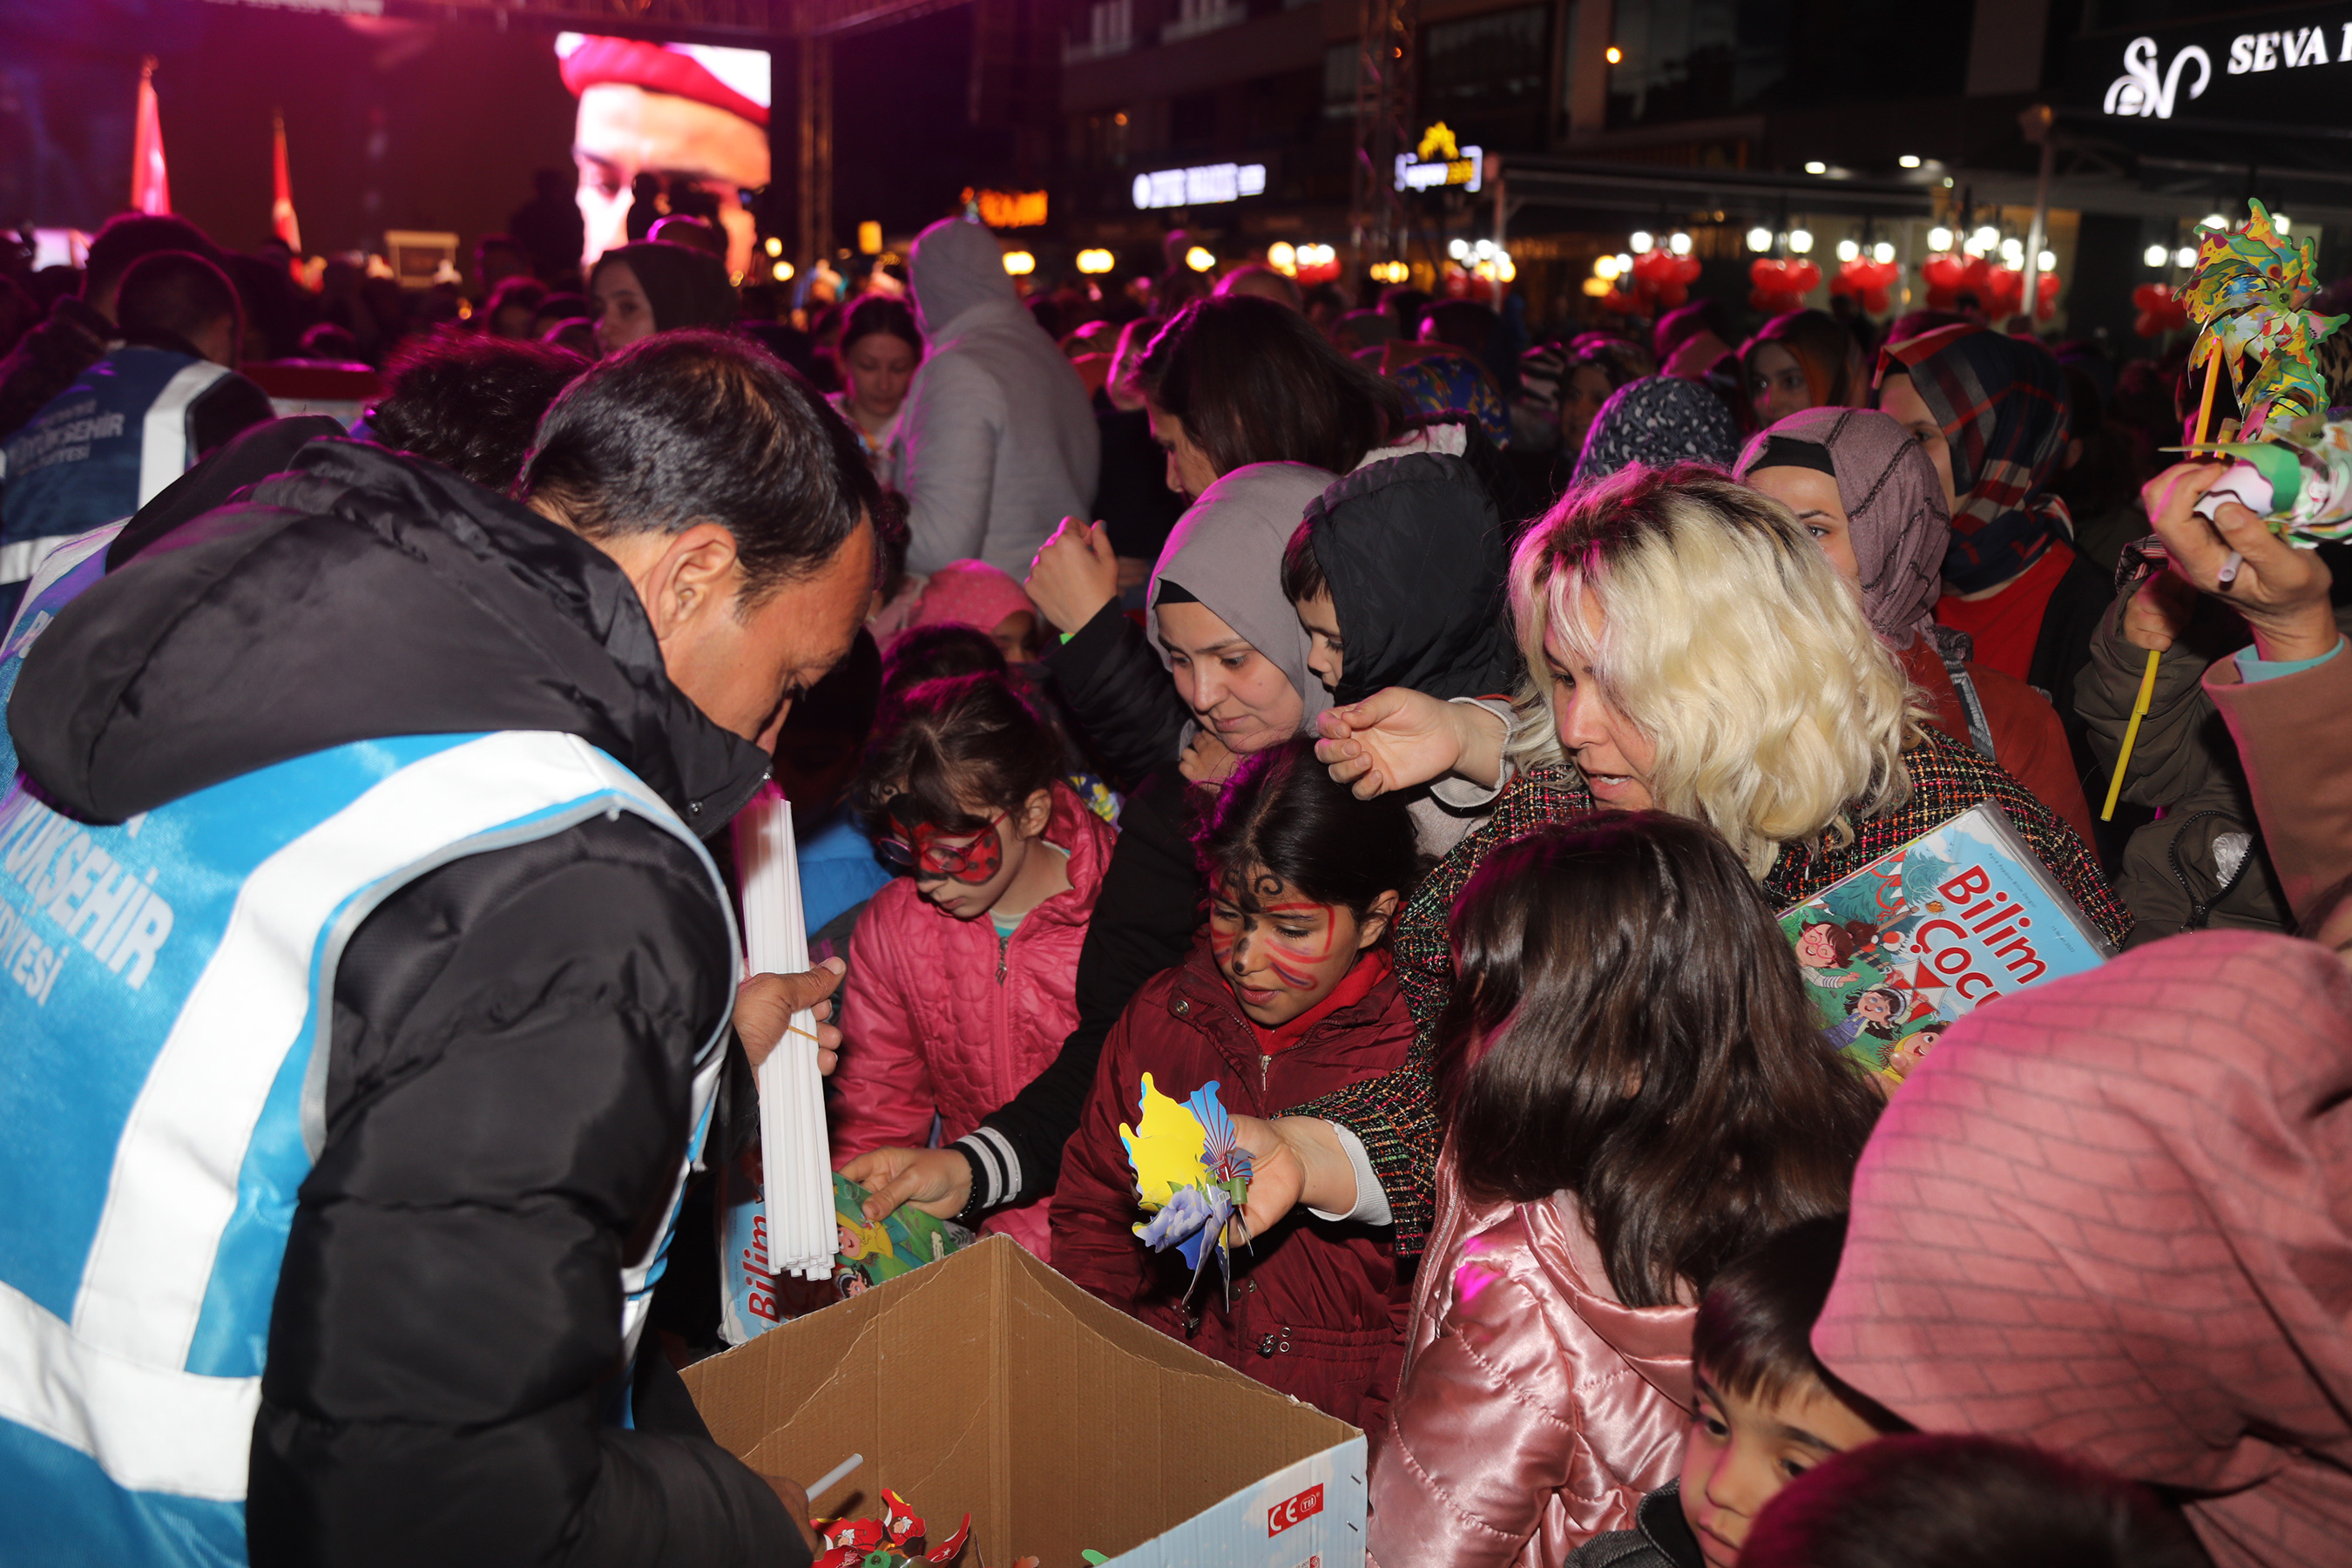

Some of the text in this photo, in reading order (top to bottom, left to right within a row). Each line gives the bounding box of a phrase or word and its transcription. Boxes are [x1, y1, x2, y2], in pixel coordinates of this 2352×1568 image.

[2227, 26, 2329, 75] SEVA
[1936, 864, 2048, 985] Bilim
[743, 1214, 781, 1324] Bilim
